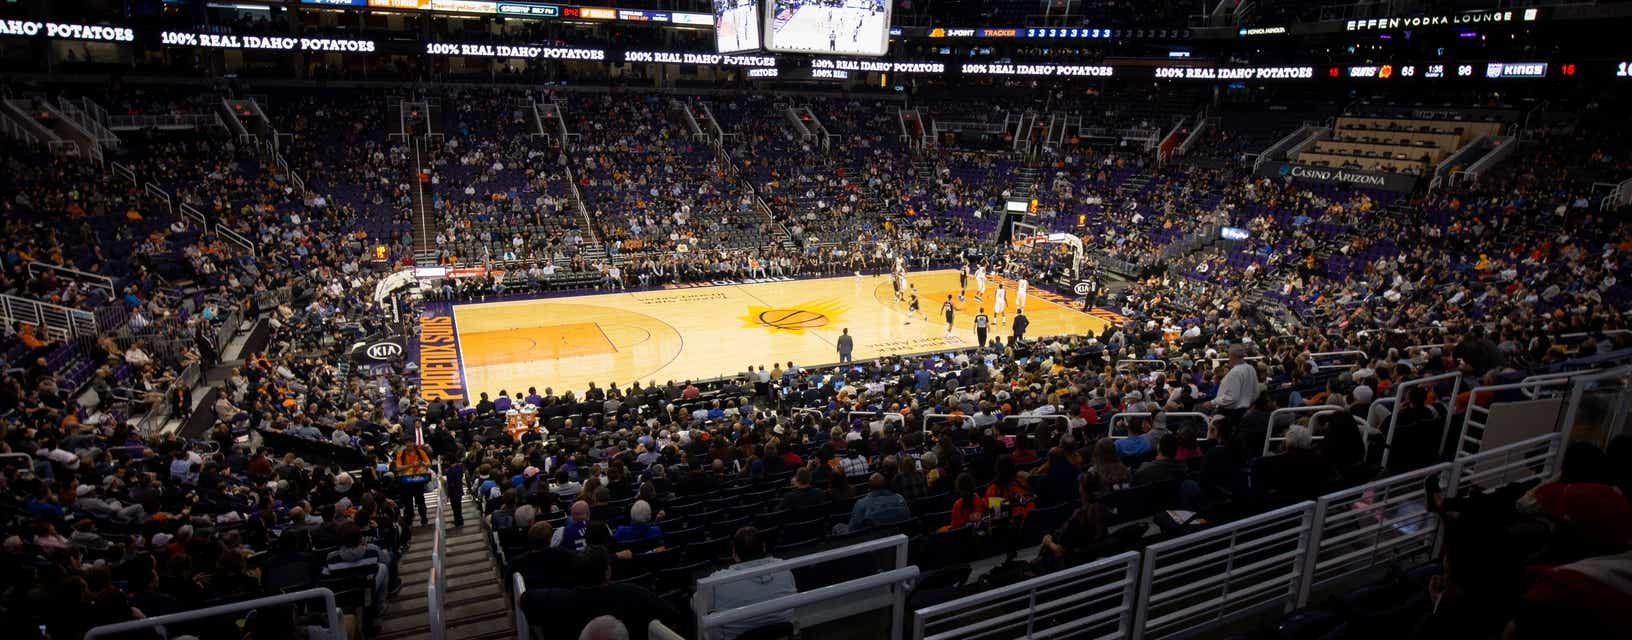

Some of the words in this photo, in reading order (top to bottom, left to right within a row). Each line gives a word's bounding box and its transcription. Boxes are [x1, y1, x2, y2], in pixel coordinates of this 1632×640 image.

[1347, 18, 1400, 31] EFFEN
[1404, 16, 1448, 26] VODKA
[1454, 11, 1512, 24] LOUNGE
[46, 23, 134, 41] POTATOES
[947, 29, 975, 37] 3-POINT
[162, 32, 197, 45] 100%
[199, 34, 241, 47] REAL
[300, 39, 375, 51] POTATOES
[427, 43, 459, 54] 100%
[462, 45, 494, 55] REAL
[543, 48, 604, 60] POTATOES
[625, 51, 652, 61] 100%
[654, 52, 682, 62] REAL
[836, 61, 859, 70] REAL
[894, 64, 944, 72] POTATOES
[962, 64, 987, 73] 100%
[989, 65, 1015, 74] REAL
[1057, 66, 1112, 76] POTATOES
[1401, 66, 1414, 76] 65
[1458, 65, 1472, 76] 96
[1503, 65, 1544, 75] KINGS
[1561, 64, 1576, 76] 15
[1155, 68, 1184, 77] 100%
[1186, 68, 1215, 78] REAL
[1256, 68, 1312, 78] POTATOES
[1291, 166, 1330, 180] CASINO
[1333, 170, 1385, 185] ARIZONA
[372, 346, 396, 357] KIA
